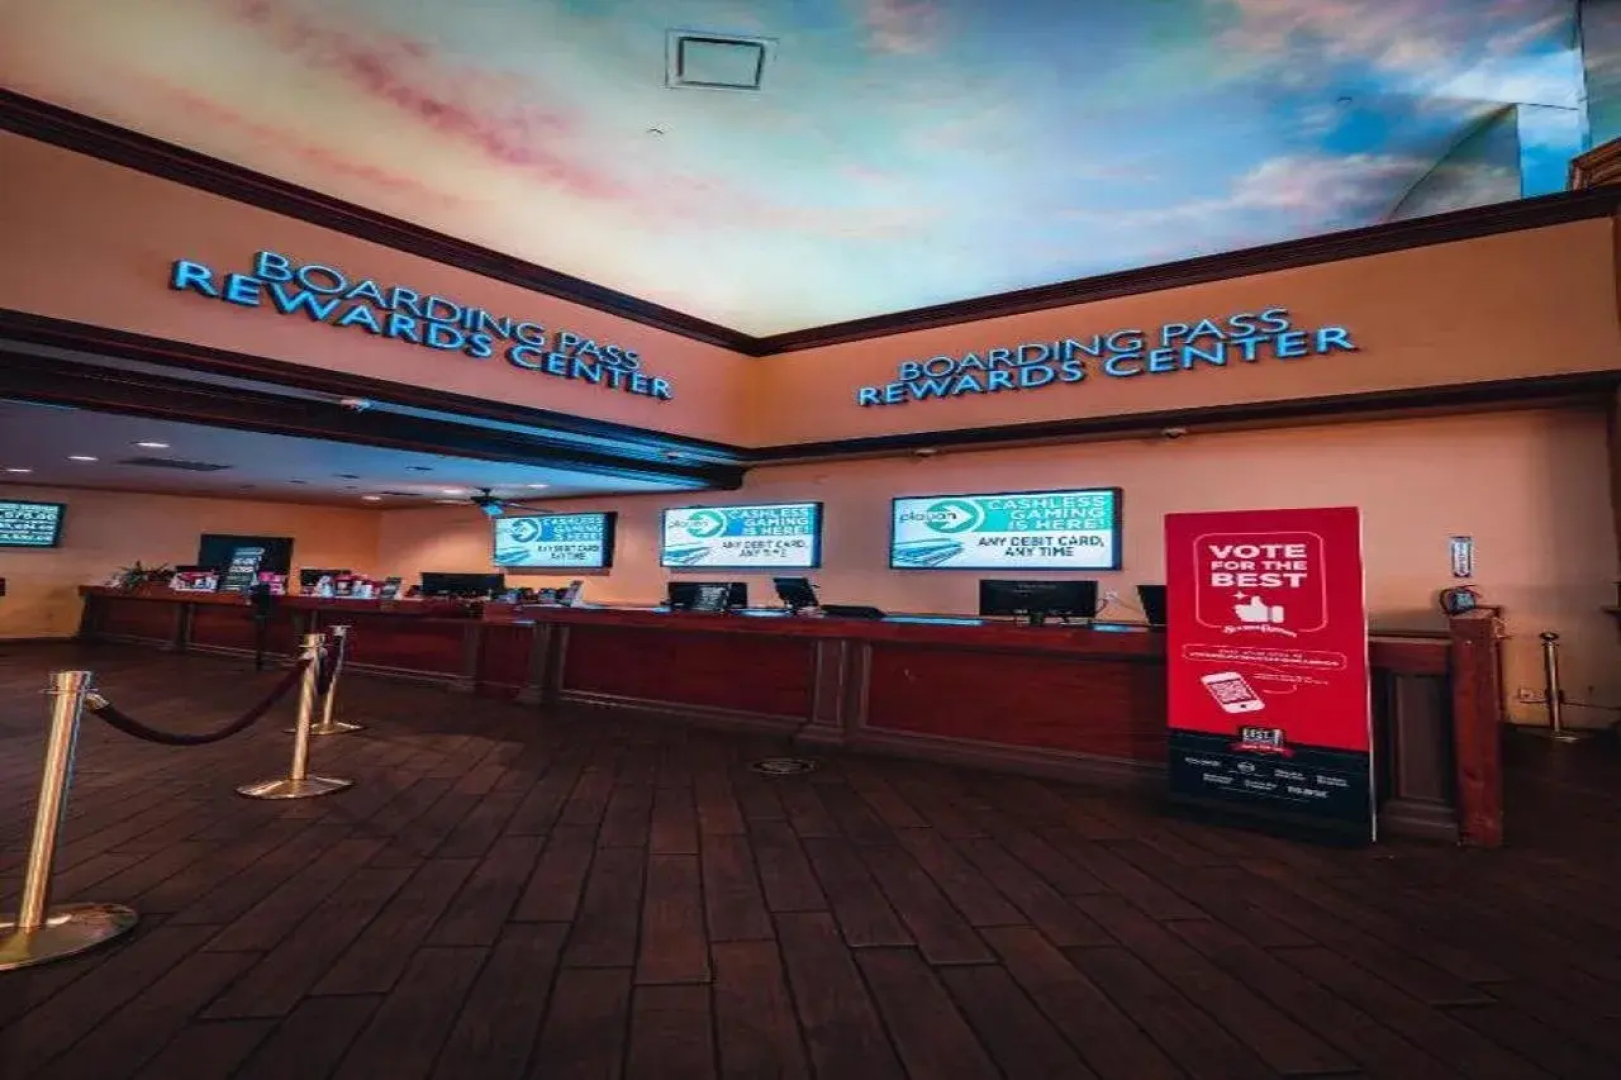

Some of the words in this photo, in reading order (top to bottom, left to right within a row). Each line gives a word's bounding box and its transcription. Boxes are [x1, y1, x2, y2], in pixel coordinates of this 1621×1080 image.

[254, 250, 545, 347] BOARDING
[556, 331, 641, 373] PASS
[171, 257, 494, 360] REWARDS
[506, 345, 674, 401] CENTER
[899, 329, 1143, 383] BOARDING
[1162, 307, 1293, 348] PASS
[859, 360, 1087, 408] REWARDS
[1103, 326, 1357, 378] CENTER
[988, 496, 1105, 510] CASHLESS
[1010, 508, 1105, 520] GAMING
[1008, 521, 1028, 530] IS
[979, 537, 1008, 546] ANY
[1011, 536, 1053, 546] DEBIT
[1005, 547, 1035, 557] ANY
[1039, 546, 1075, 557] TIME
[1209, 544, 1307, 559] VOTE
[1211, 561, 1255, 571] FOR
[1262, 560, 1307, 570] THE
[1211, 573, 1307, 588] BEST
